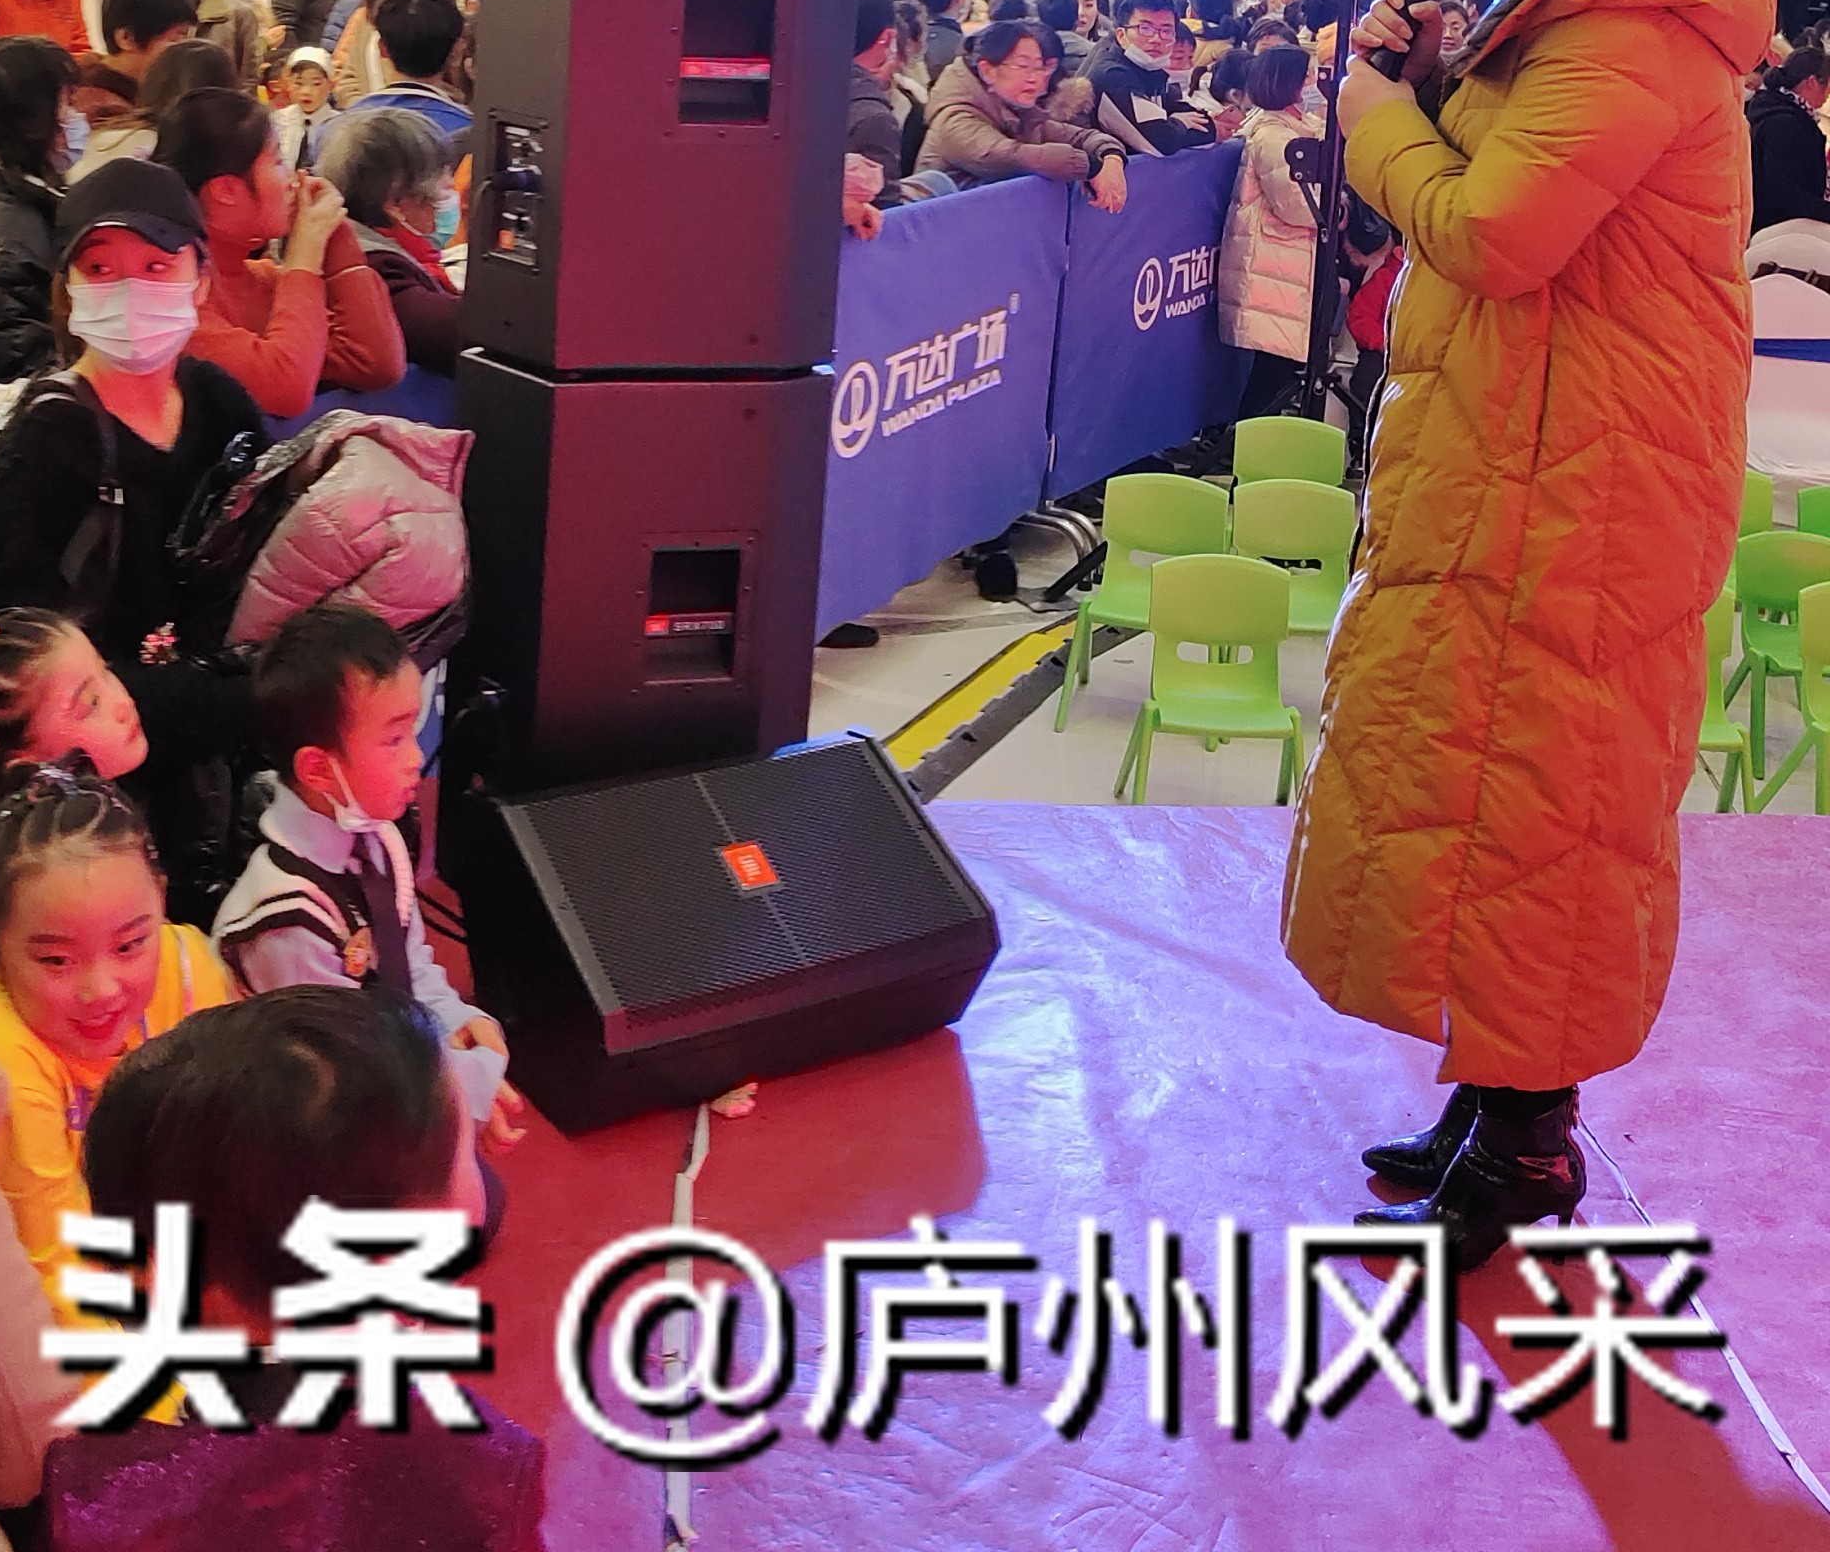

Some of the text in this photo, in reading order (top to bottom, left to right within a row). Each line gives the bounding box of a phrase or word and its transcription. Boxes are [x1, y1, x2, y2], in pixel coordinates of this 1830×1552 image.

[1165, 292, 1206, 319] WANDA
[882, 309, 1008, 412] 万达广场
[881, 368, 1003, 438] WANDA PLAZA
